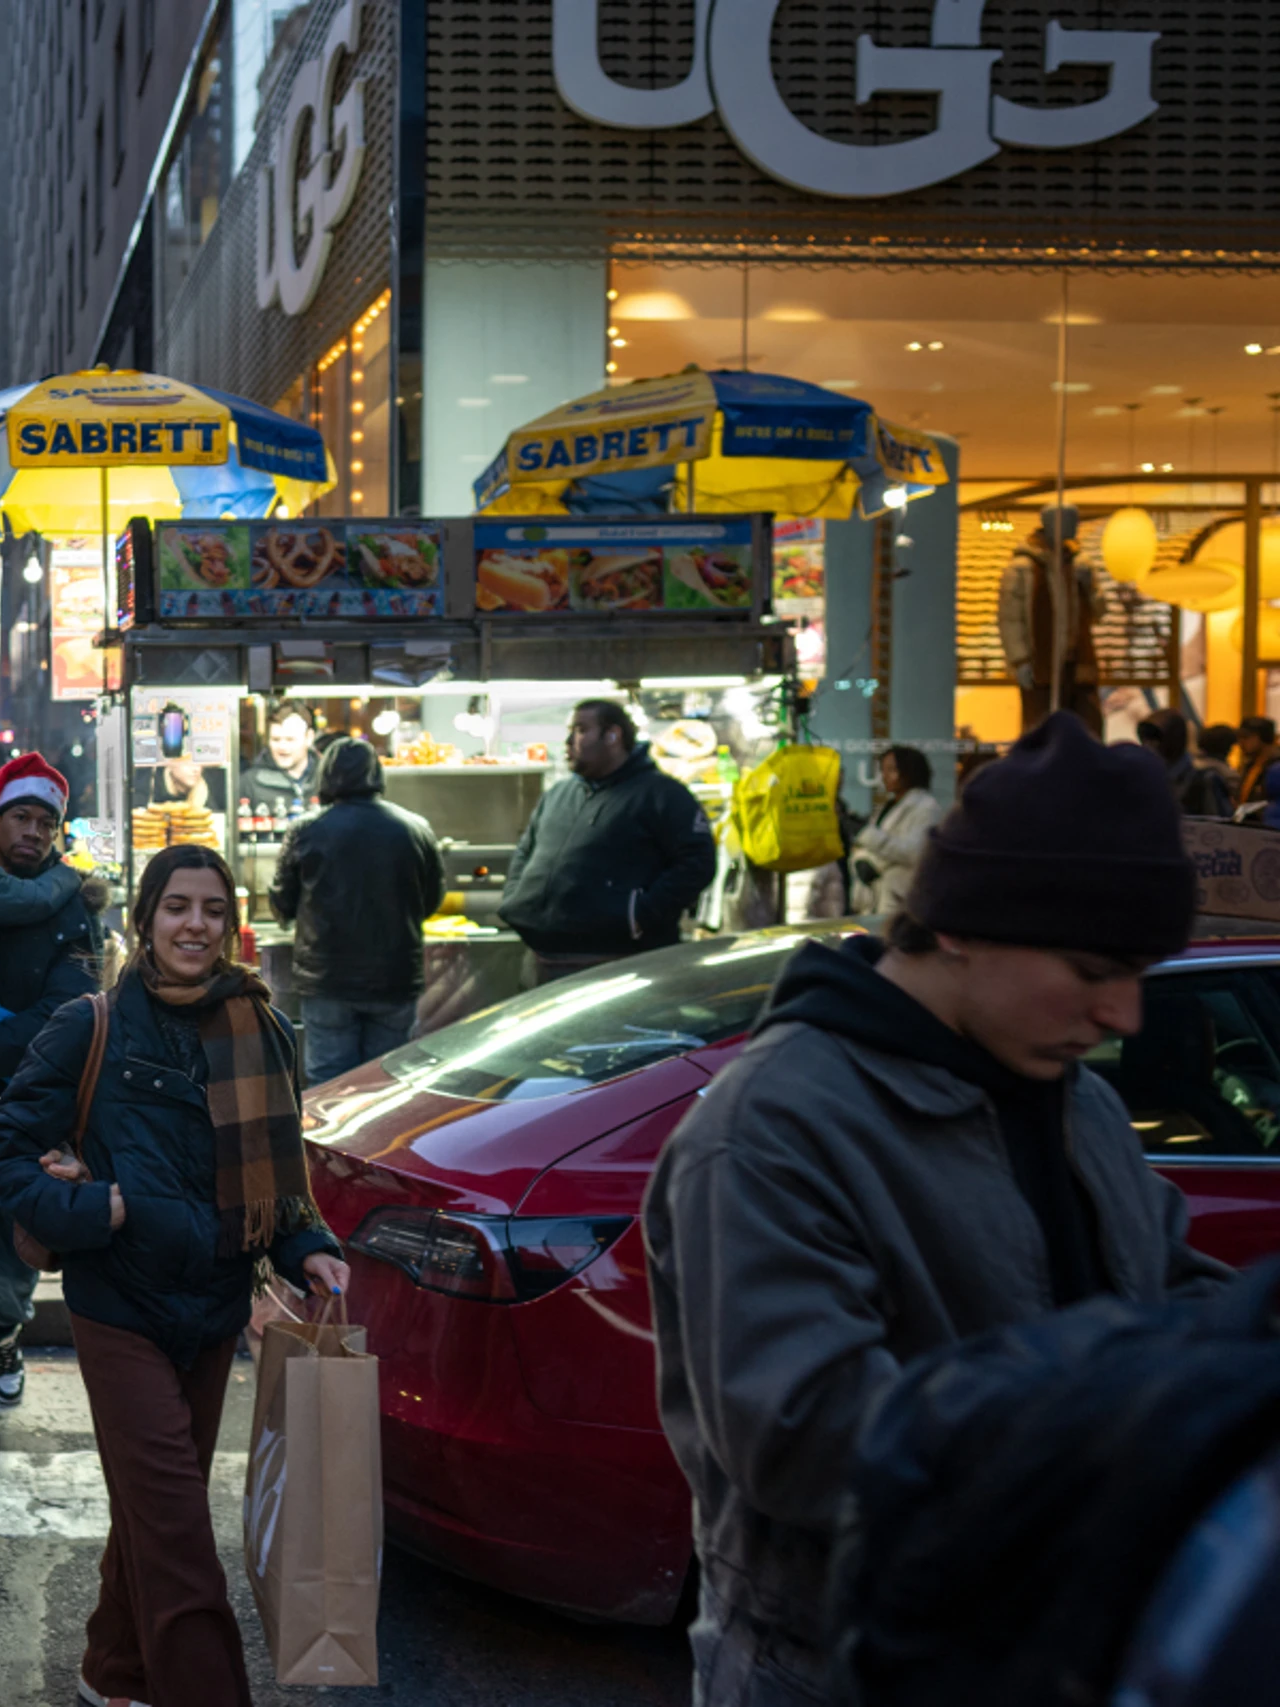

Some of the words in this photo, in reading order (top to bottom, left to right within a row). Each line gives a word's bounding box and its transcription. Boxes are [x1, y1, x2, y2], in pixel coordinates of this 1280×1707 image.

[551, 0, 1161, 198] UGG
[20, 422, 220, 455] SABRETT
[517, 416, 706, 472] SABRETT
